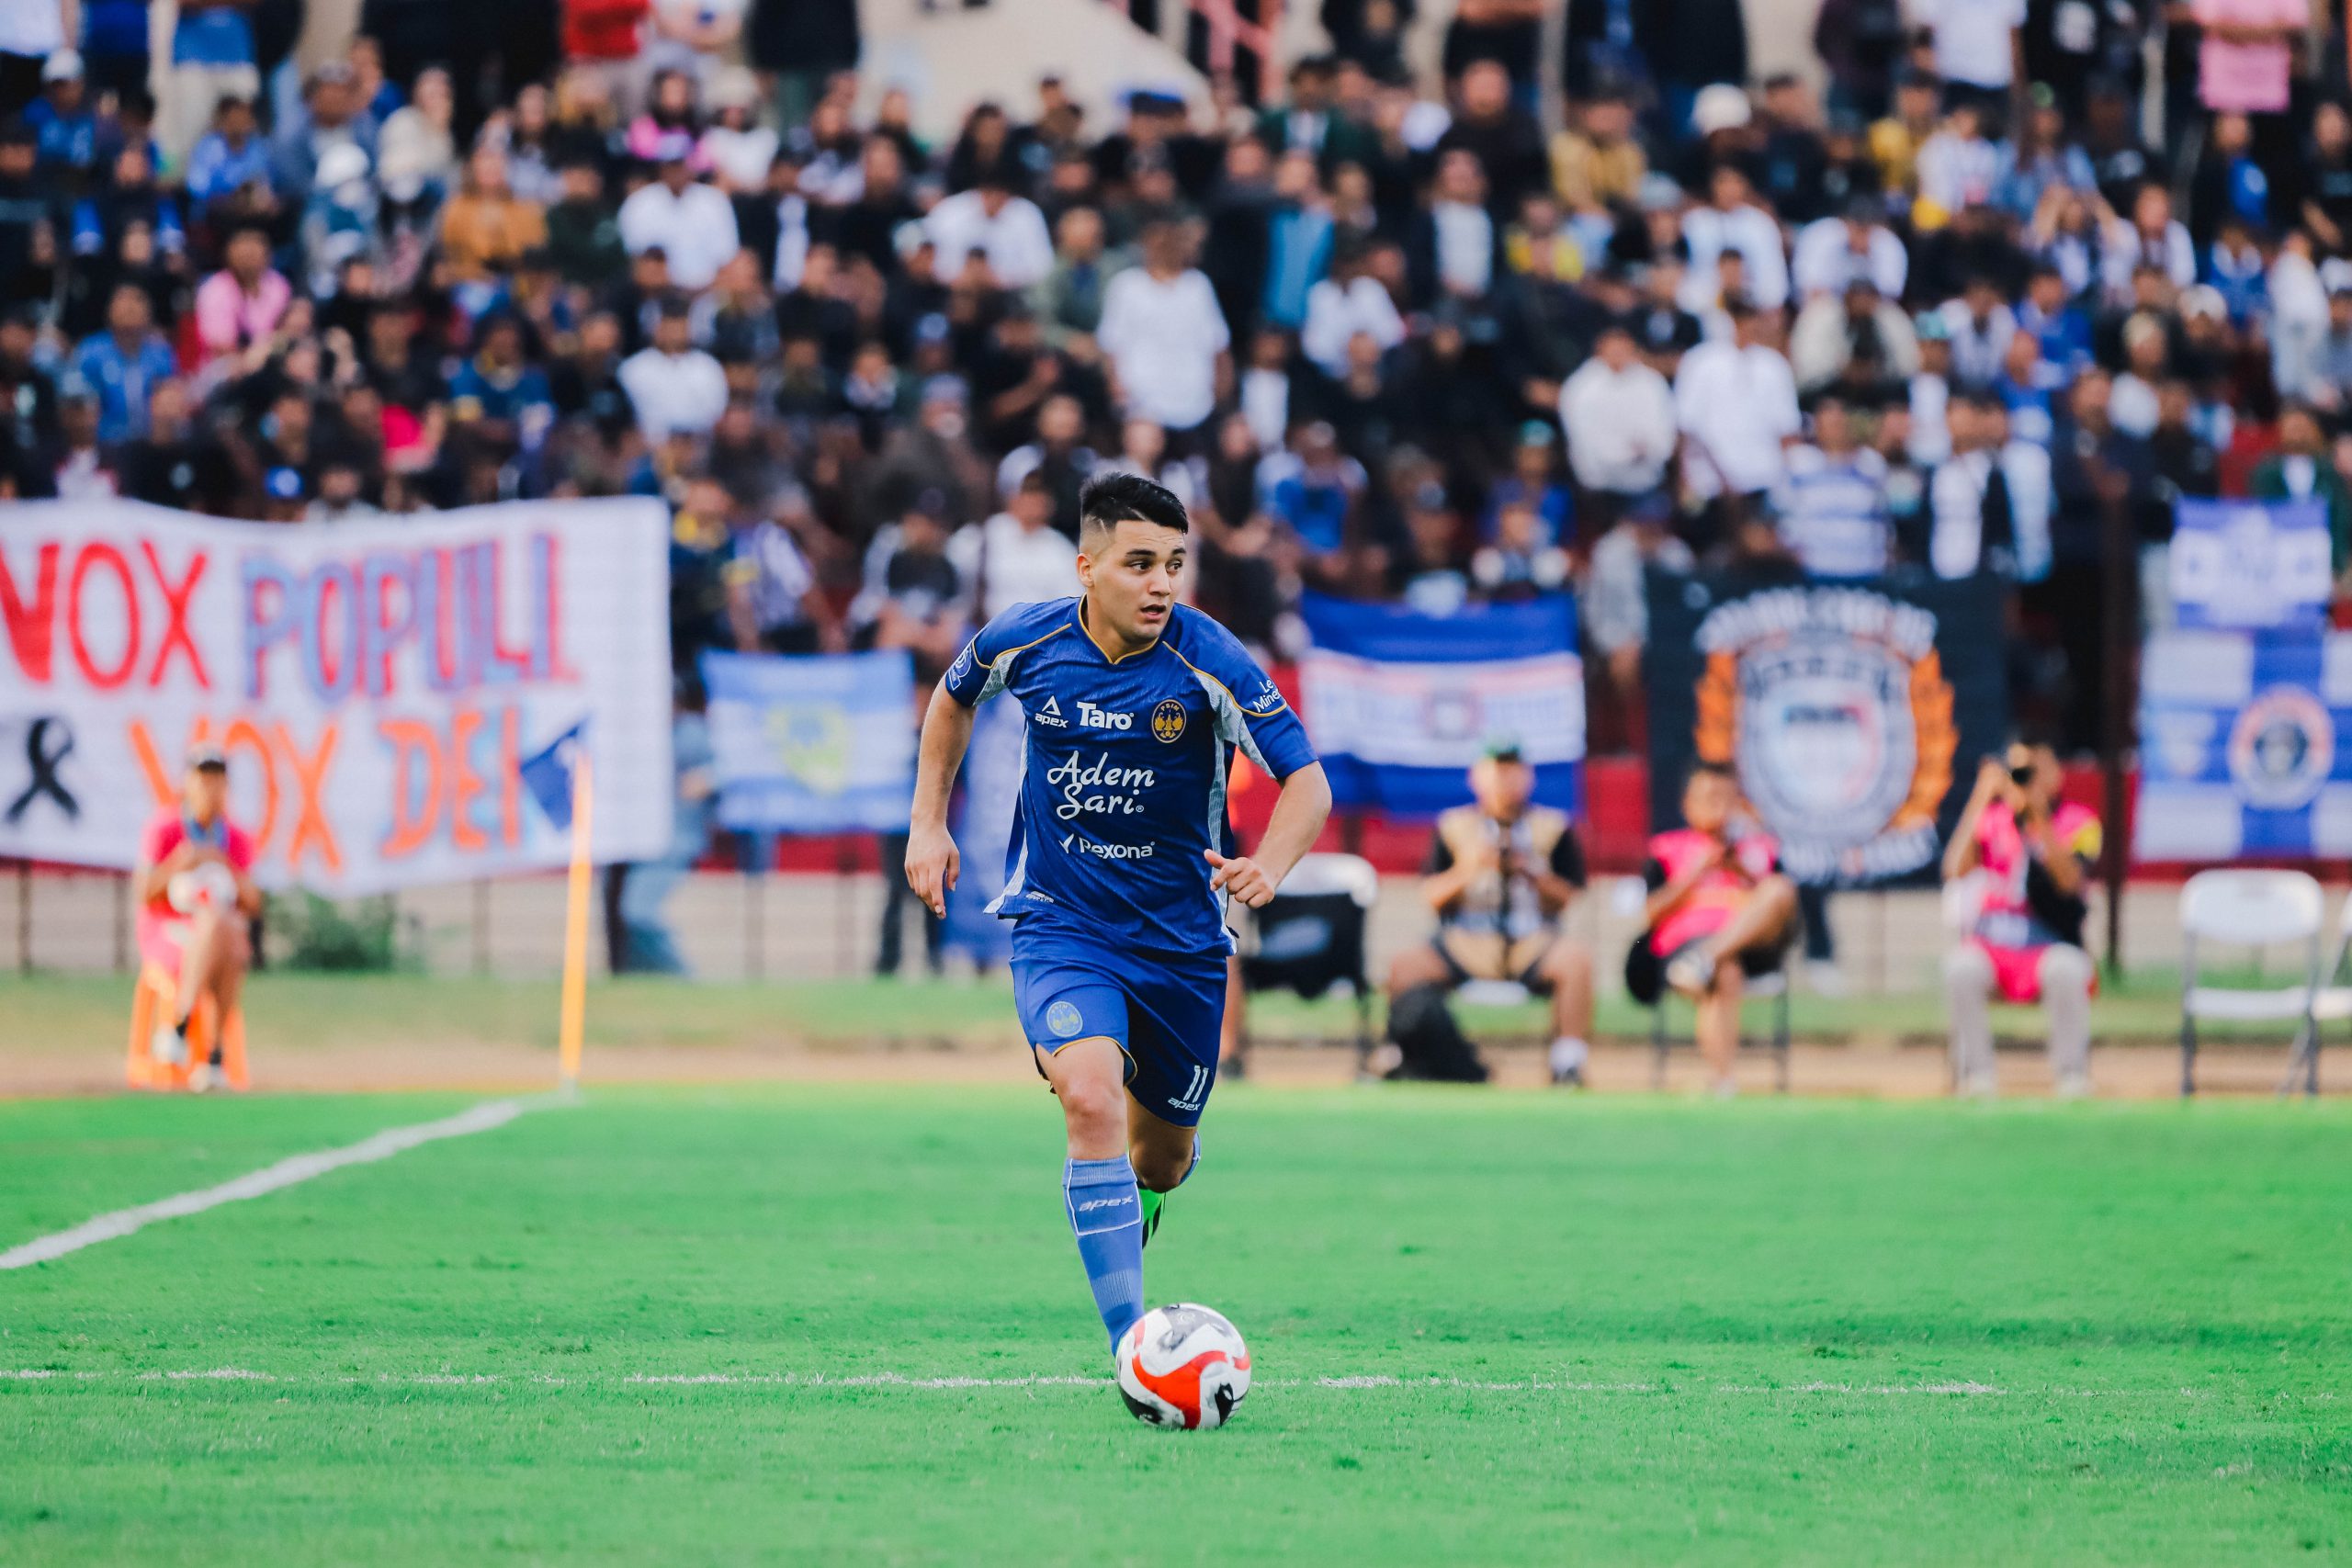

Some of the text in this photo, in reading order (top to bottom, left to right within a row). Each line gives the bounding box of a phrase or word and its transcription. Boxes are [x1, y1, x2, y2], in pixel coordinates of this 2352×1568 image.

[0, 532, 579, 703] VOX POPULI
[1035, 713, 1069, 728] apex
[1076, 701, 1134, 730] Taro
[378, 701, 526, 860] DEI
[1046, 750, 1155, 787] Adem
[1056, 782, 1136, 820] Sari
[1182, 1065, 1209, 1103] 11
[1168, 1097, 1201, 1111] apex
[1079, 1195, 1134, 1212] apex
